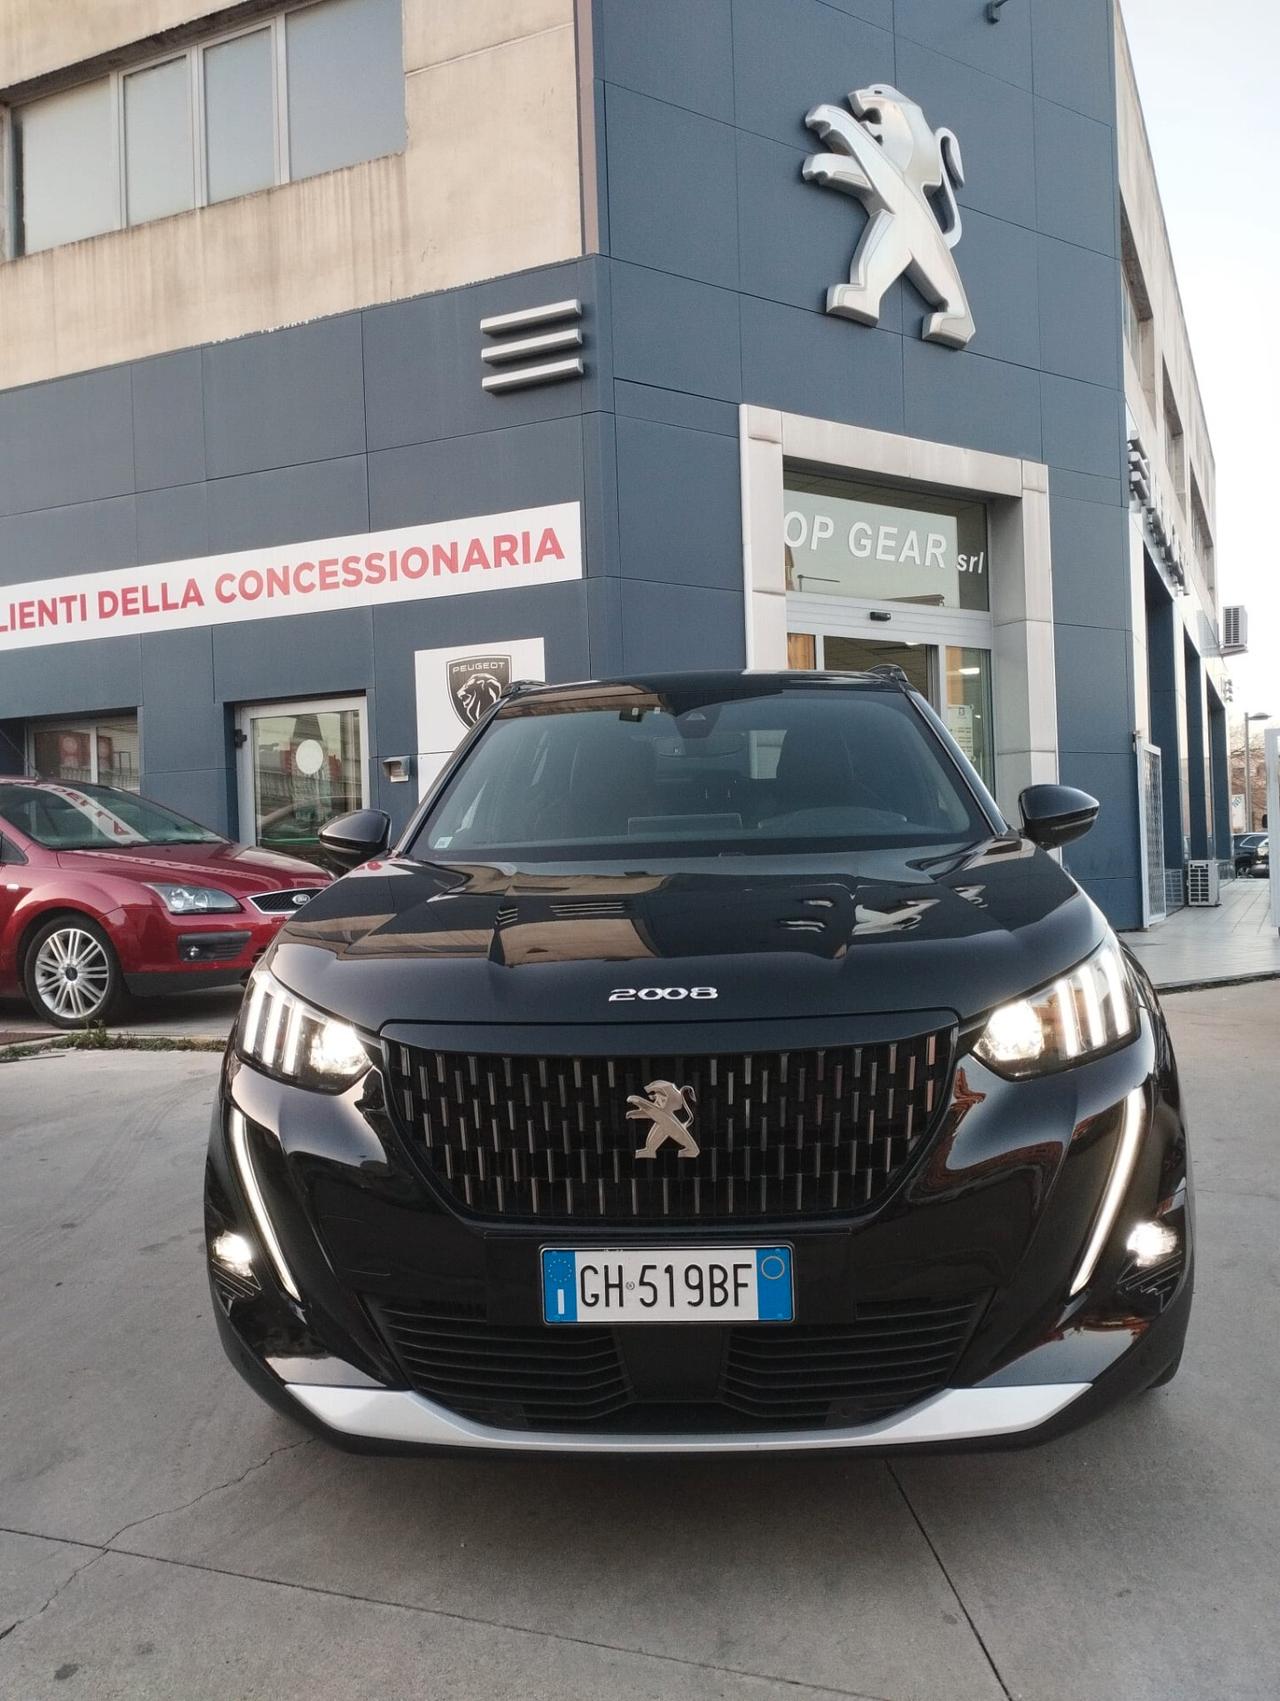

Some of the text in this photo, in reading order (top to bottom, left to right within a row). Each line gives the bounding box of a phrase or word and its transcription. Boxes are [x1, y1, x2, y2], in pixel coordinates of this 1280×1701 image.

[784, 510, 984, 574] OP GEAR srl
[0, 527, 565, 632] IENTI DELLA CONCESSIONARIA
[452, 661, 505, 674] PEUGEOT
[608, 986, 719, 1002] 2008
